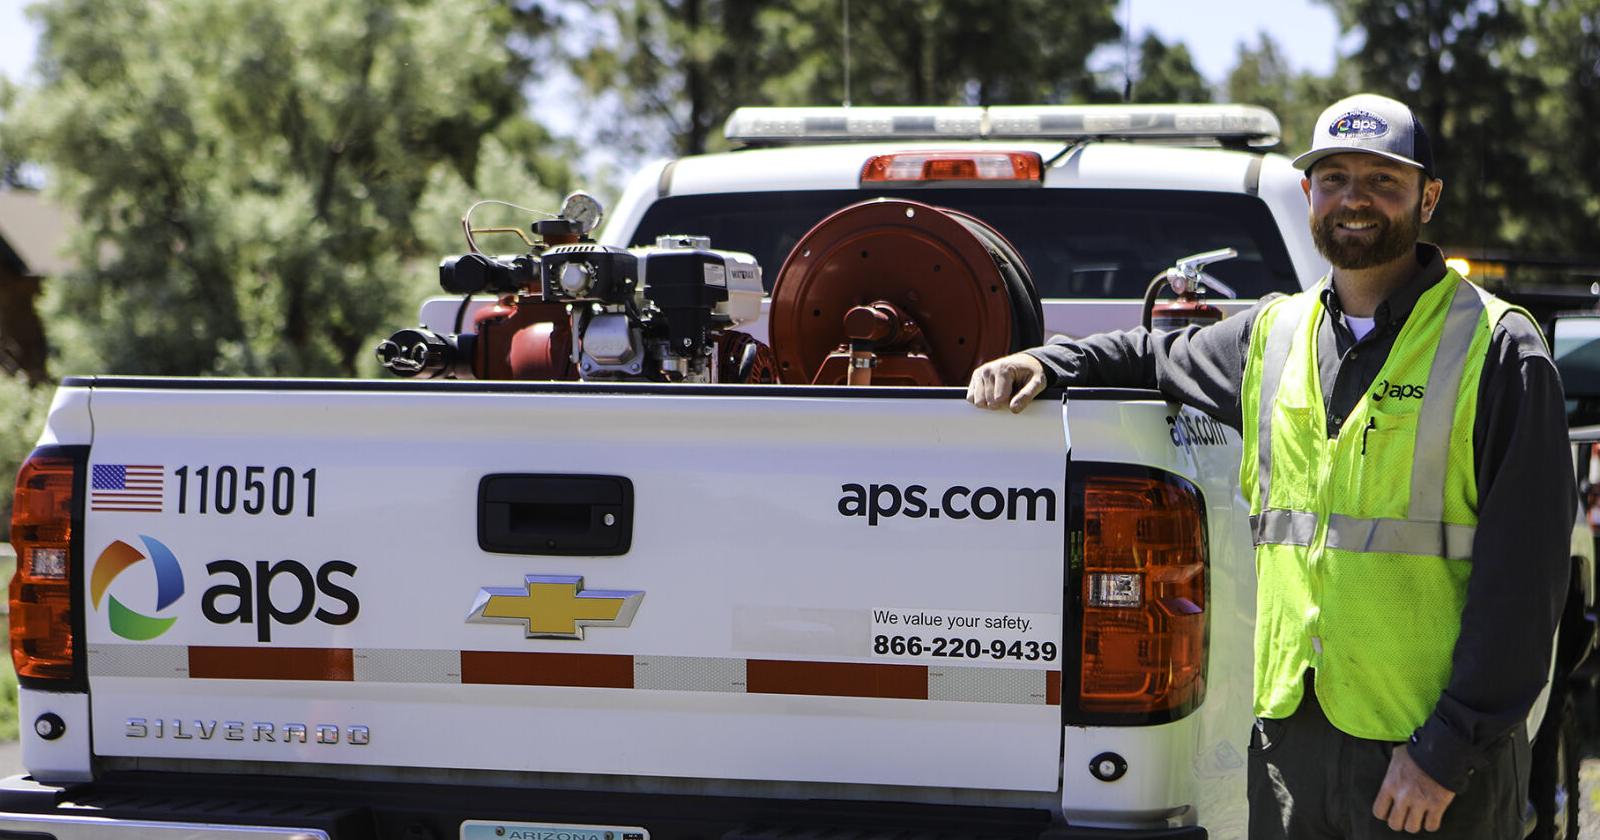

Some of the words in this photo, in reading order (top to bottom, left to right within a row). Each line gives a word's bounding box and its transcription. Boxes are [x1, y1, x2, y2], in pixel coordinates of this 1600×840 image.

[1352, 119, 1377, 131] aps
[1389, 384, 1425, 401] aps
[1166, 415, 1227, 455] aps.com
[174, 465, 317, 517] 110501
[837, 483, 1057, 527] aps.com
[201, 559, 361, 643] aps
[873, 610, 898, 625] We
[902, 612, 943, 627] value
[947, 616, 981, 631] your
[984, 615, 1033, 633] safety.
[873, 634, 1058, 662] 866-220-9439
[125, 717, 371, 746] SILVERADO
[509, 831, 600, 840] ARIZONA
